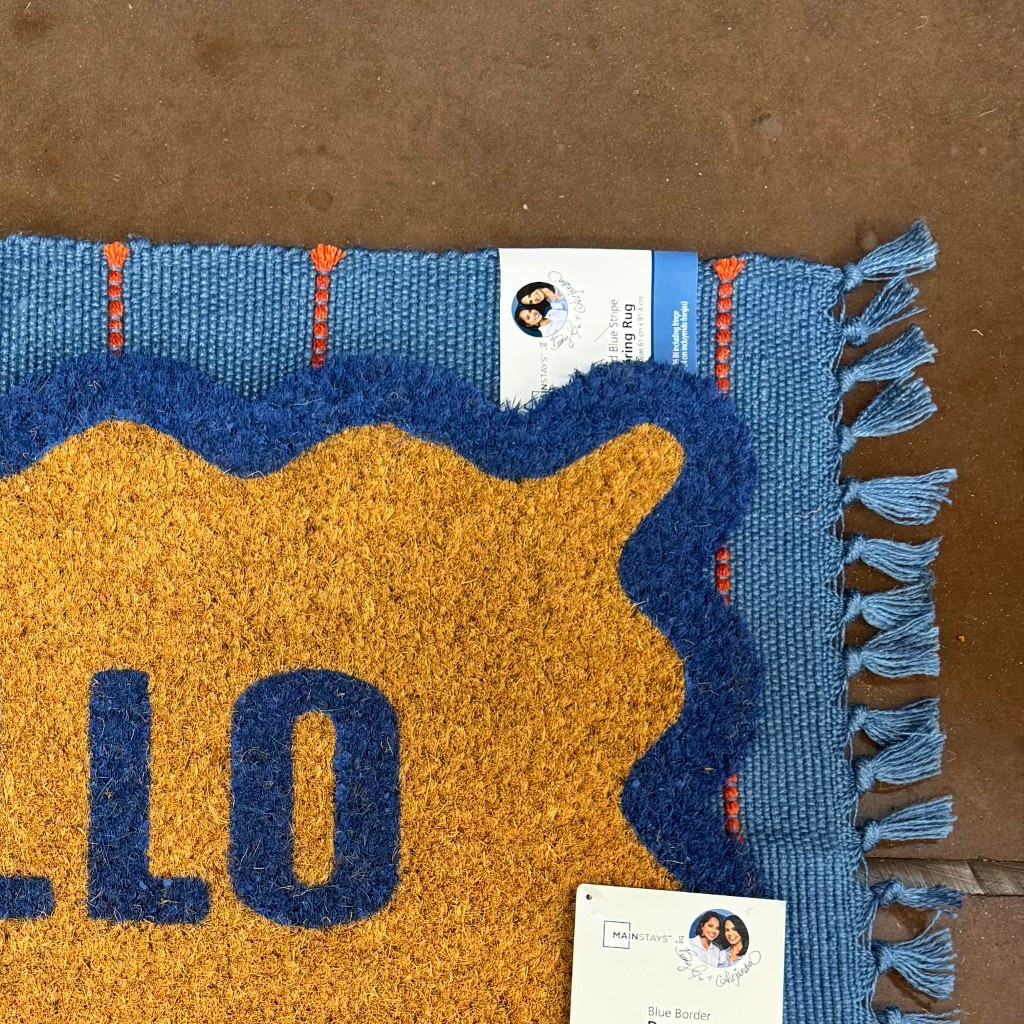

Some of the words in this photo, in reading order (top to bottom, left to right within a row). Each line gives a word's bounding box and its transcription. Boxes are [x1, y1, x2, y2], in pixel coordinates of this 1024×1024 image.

[608, 298, 621, 328] Stripe
[622, 303, 636, 328] Rug
[672, 310, 681, 326] fringe
[608, 330, 619, 352] Blue
[672, 327, 681, 351] including
[680, 322, 690, 350] incluyendo
[540, 356, 548, 398] AINSTAYS
[612, 931, 669, 943] MAINSTAYS
[648, 1006, 672, 1018] Blue
[675, 1008, 711, 1021] Border
